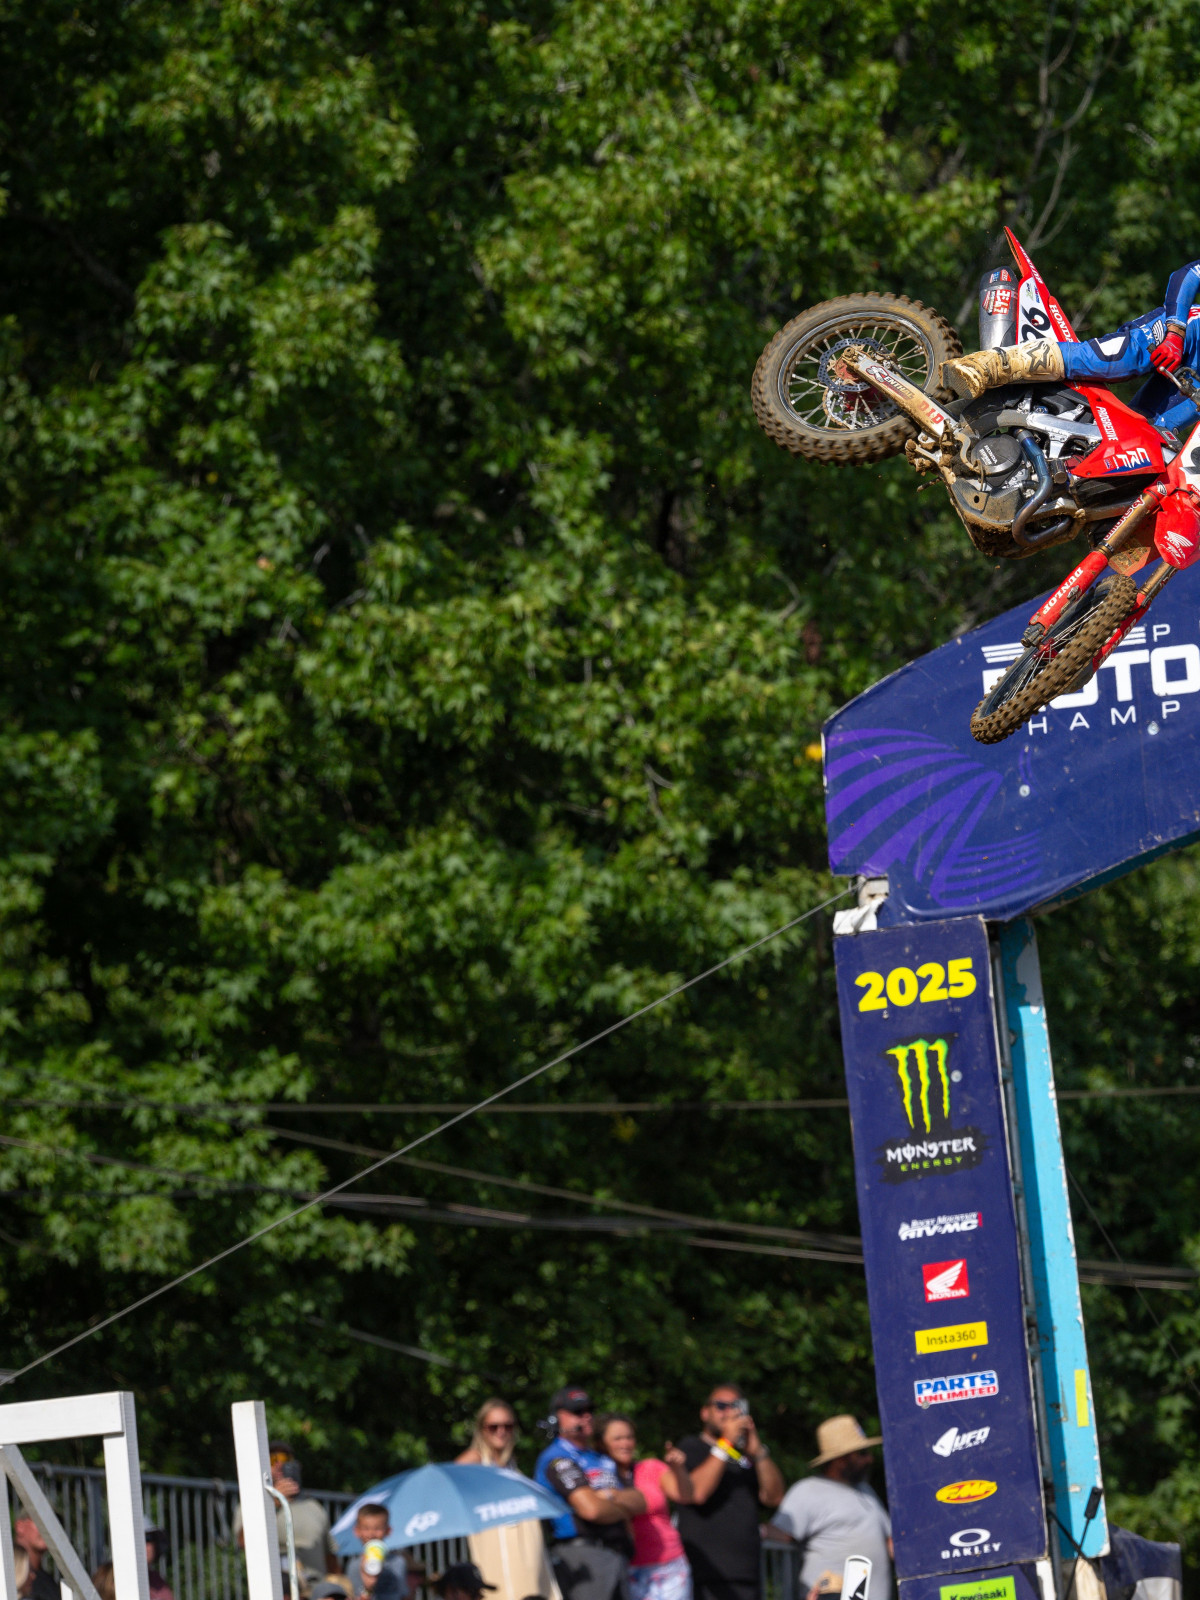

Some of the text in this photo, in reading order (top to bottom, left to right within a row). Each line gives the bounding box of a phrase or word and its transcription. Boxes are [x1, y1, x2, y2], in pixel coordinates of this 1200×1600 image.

[1096, 405, 1119, 442] PROGRESSIVE
[1116, 447, 1151, 469] CRF
[1042, 566, 1084, 615] DUNLOP
[854, 957, 977, 1013] 2025
[886, 1136, 977, 1163] MONSTER
[901, 1156, 963, 1173] ENERGY
[928, 1288, 967, 1301] HONDA
[926, 1329, 977, 1346] Insta360
[916, 1372, 995, 1395] PARTS
[918, 1385, 997, 1405] UNLIMITED
[953, 1426, 990, 1448] UFO
[941, 1542, 1002, 1560] OAKLEY
[949, 1586, 1007, 1600] Kawasaki
